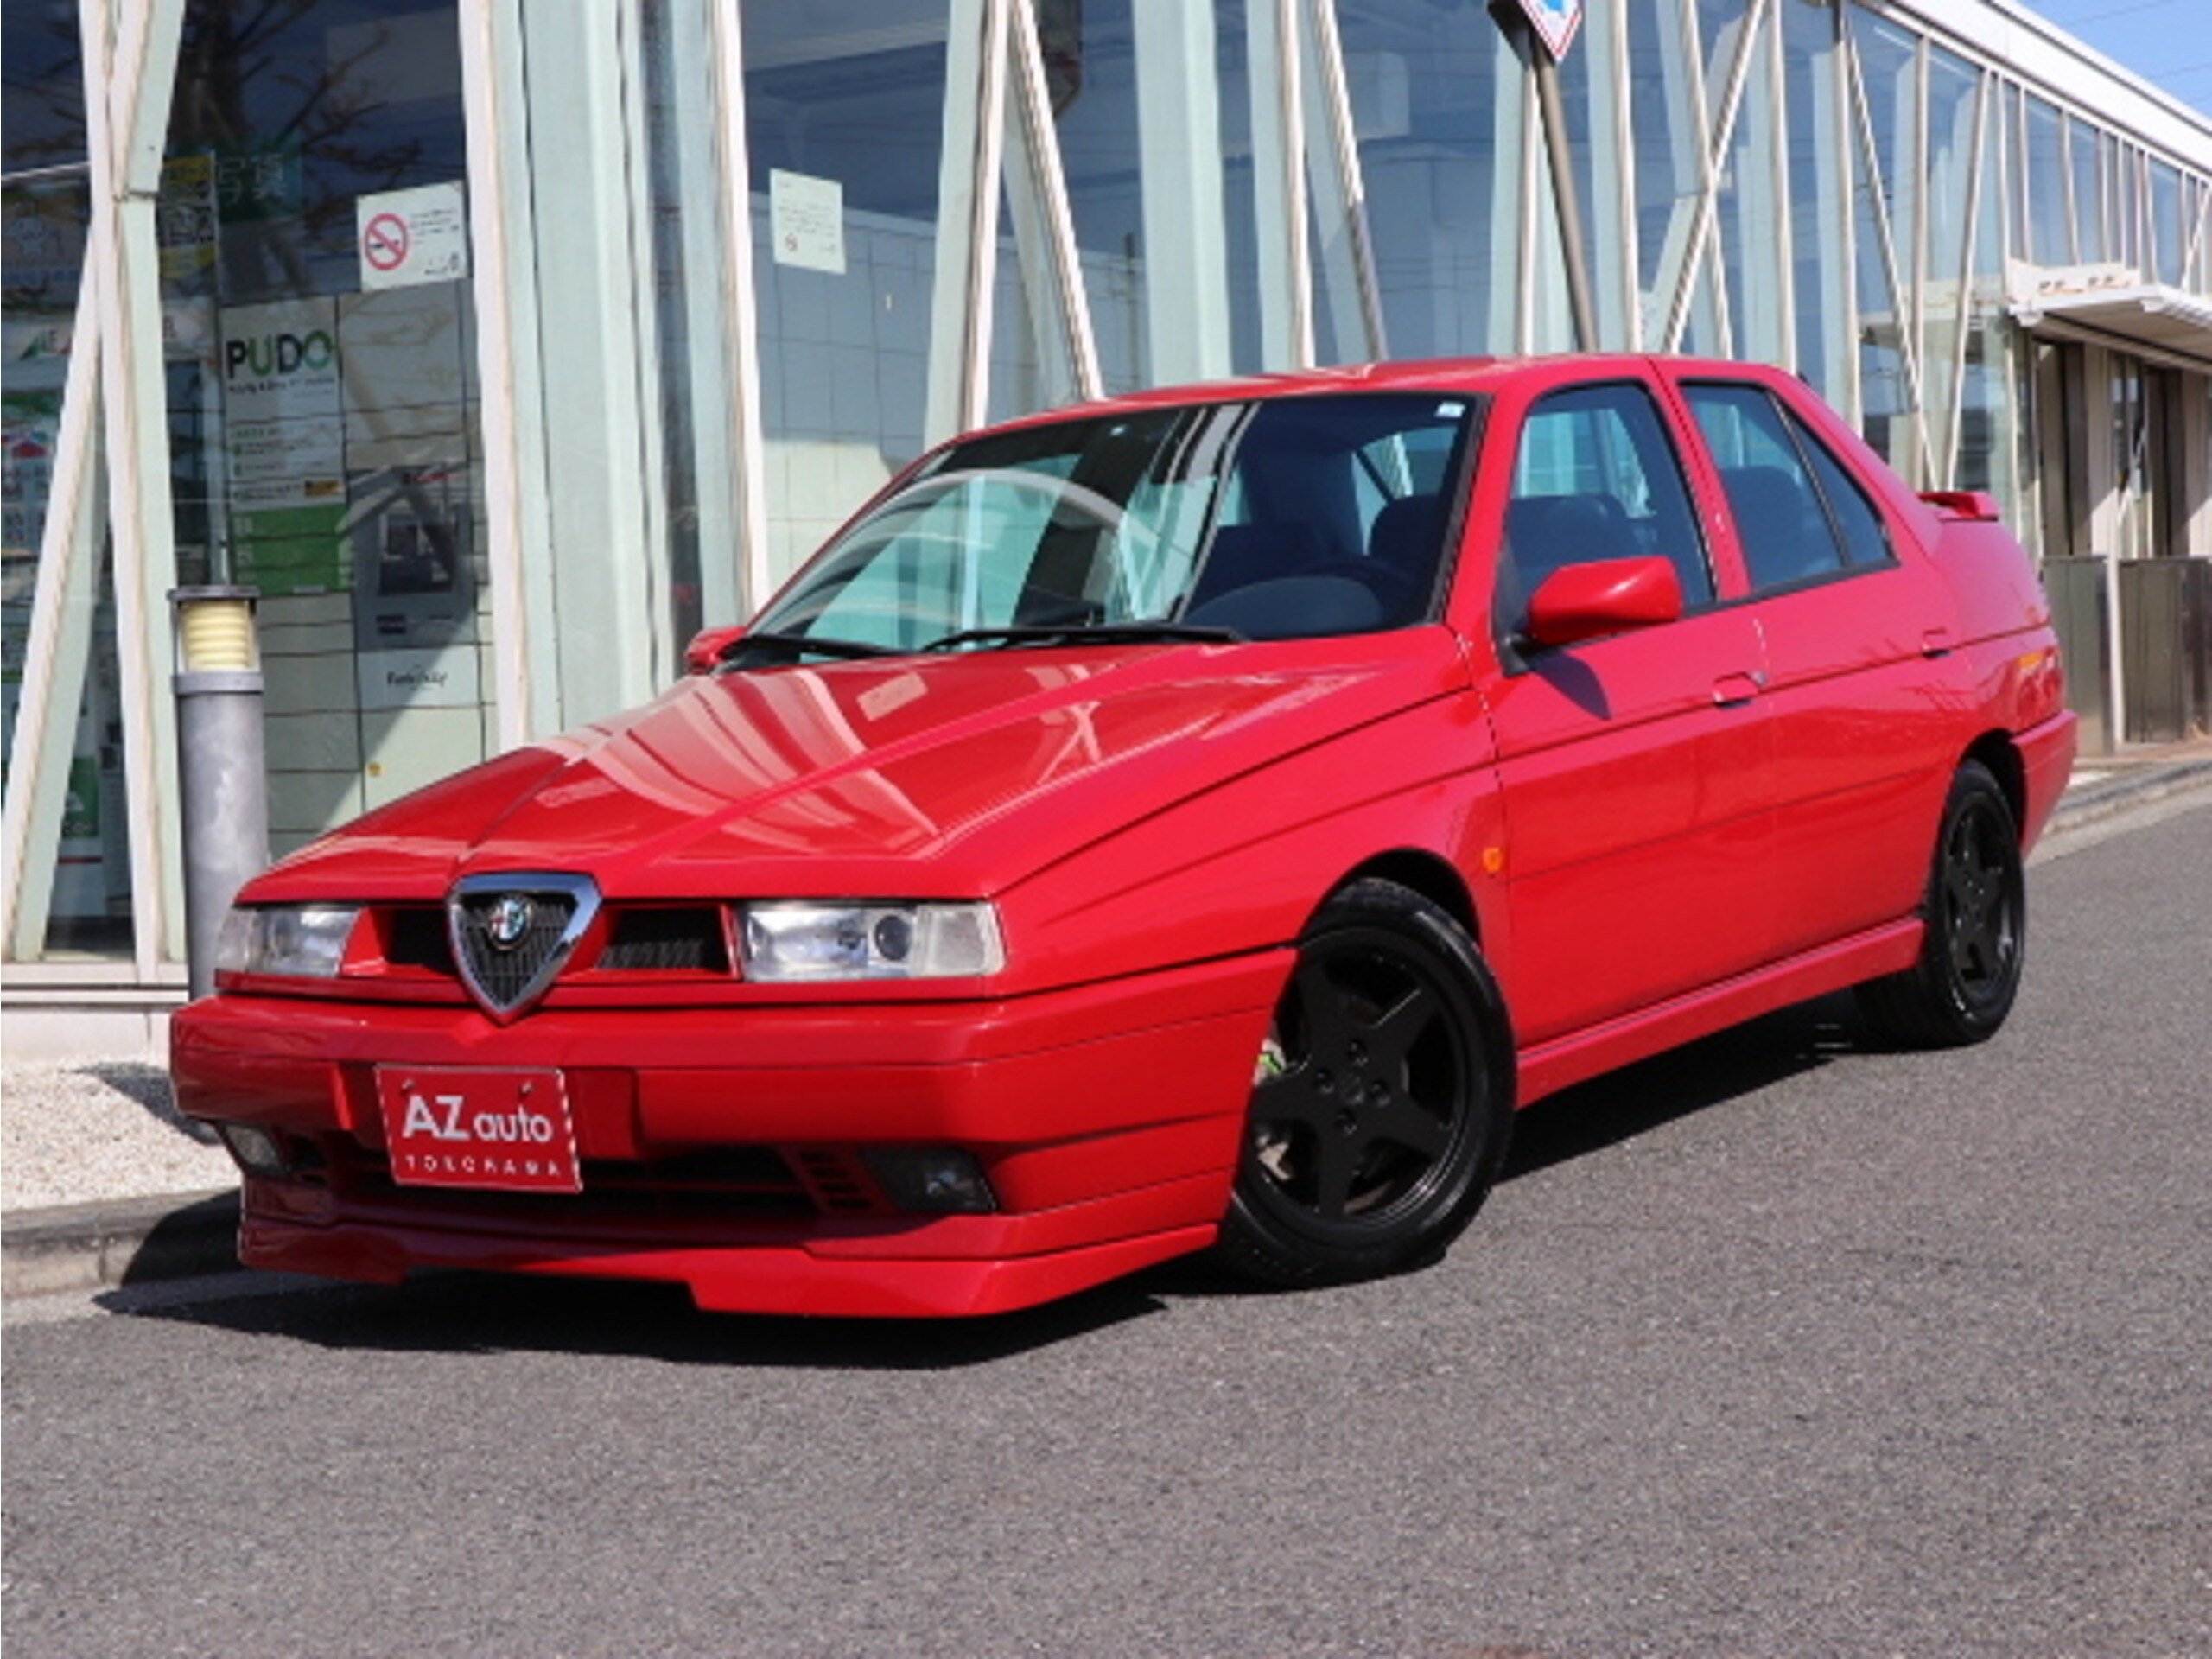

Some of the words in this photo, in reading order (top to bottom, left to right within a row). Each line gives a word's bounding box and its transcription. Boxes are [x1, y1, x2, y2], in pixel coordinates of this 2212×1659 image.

[226, 329, 334, 379] PUDO
[402, 1094, 470, 1141] AZ
[473, 1103, 554, 1142] auto
